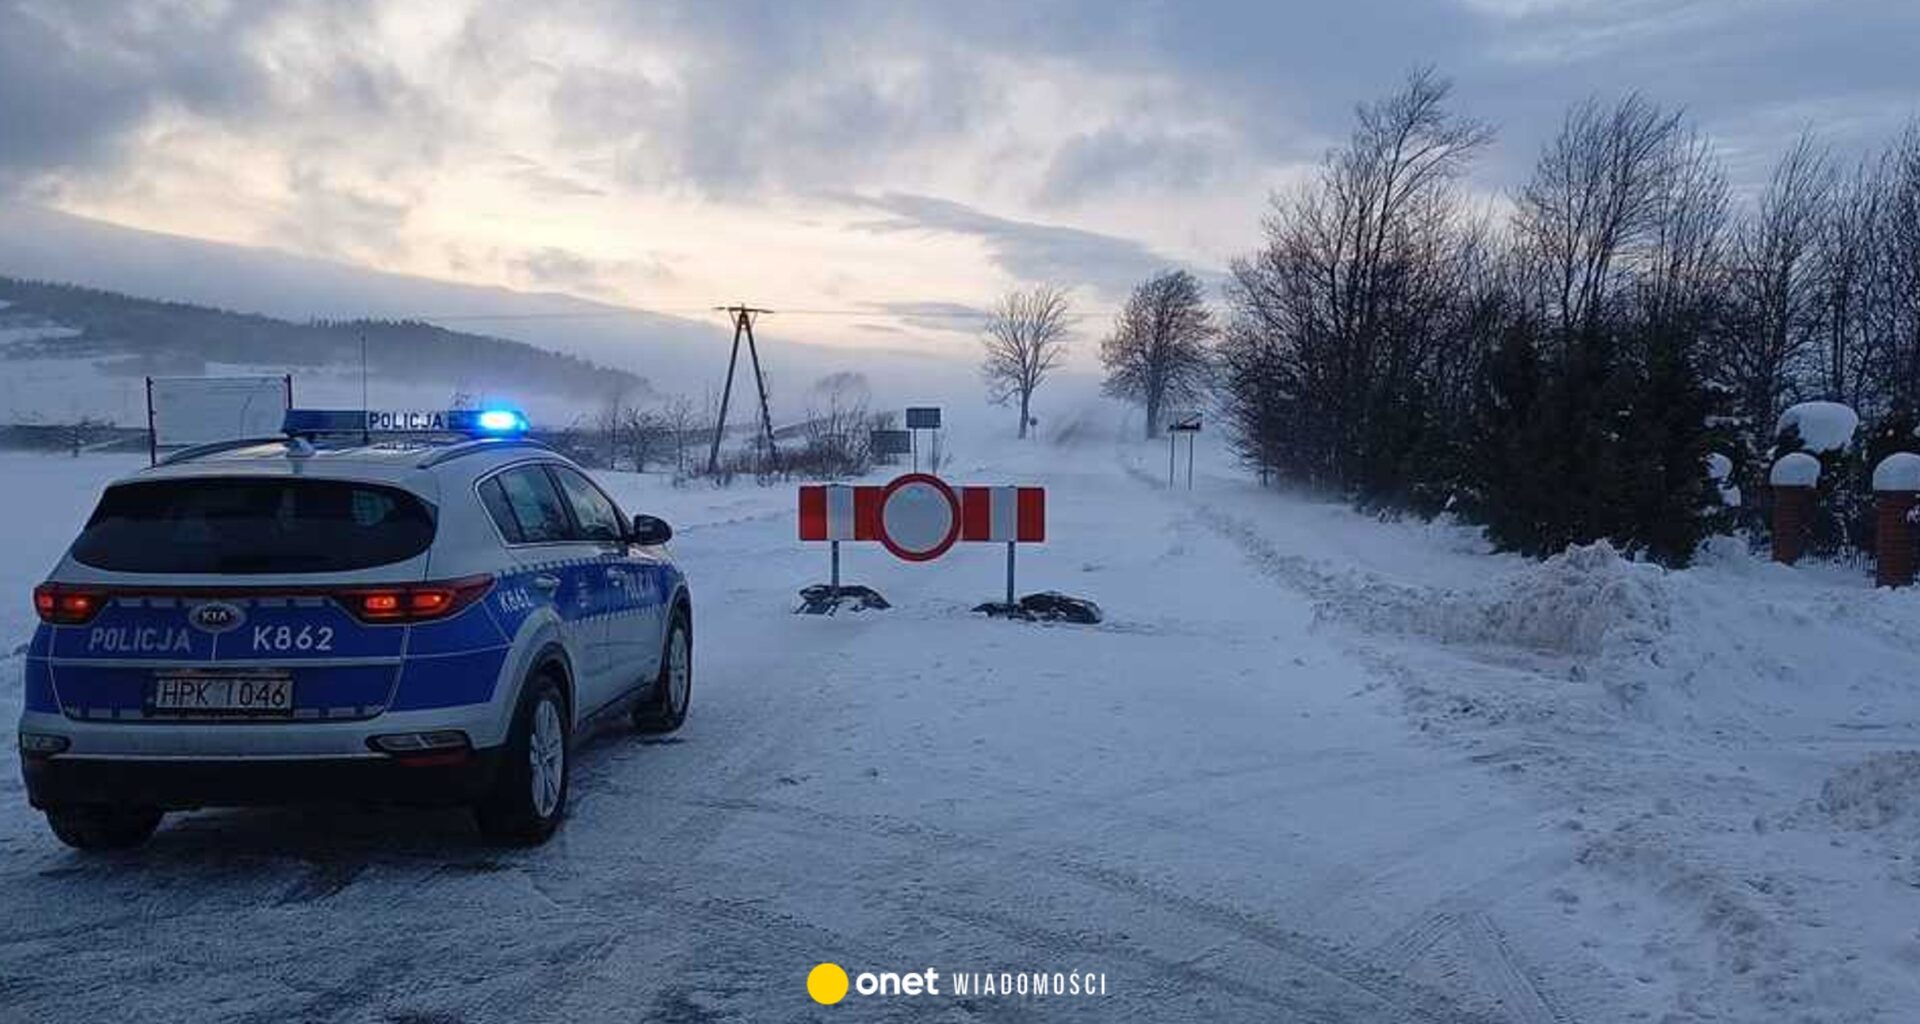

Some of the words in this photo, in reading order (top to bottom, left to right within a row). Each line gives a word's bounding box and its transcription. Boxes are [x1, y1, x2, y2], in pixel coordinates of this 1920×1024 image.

[368, 411, 443, 429] POLICJA
[202, 611, 228, 621] KIA
[89, 627, 192, 652] POLICJA
[253, 625, 334, 651] K862
[162, 682, 209, 705] HPK
[221, 682, 287, 706] 1046
